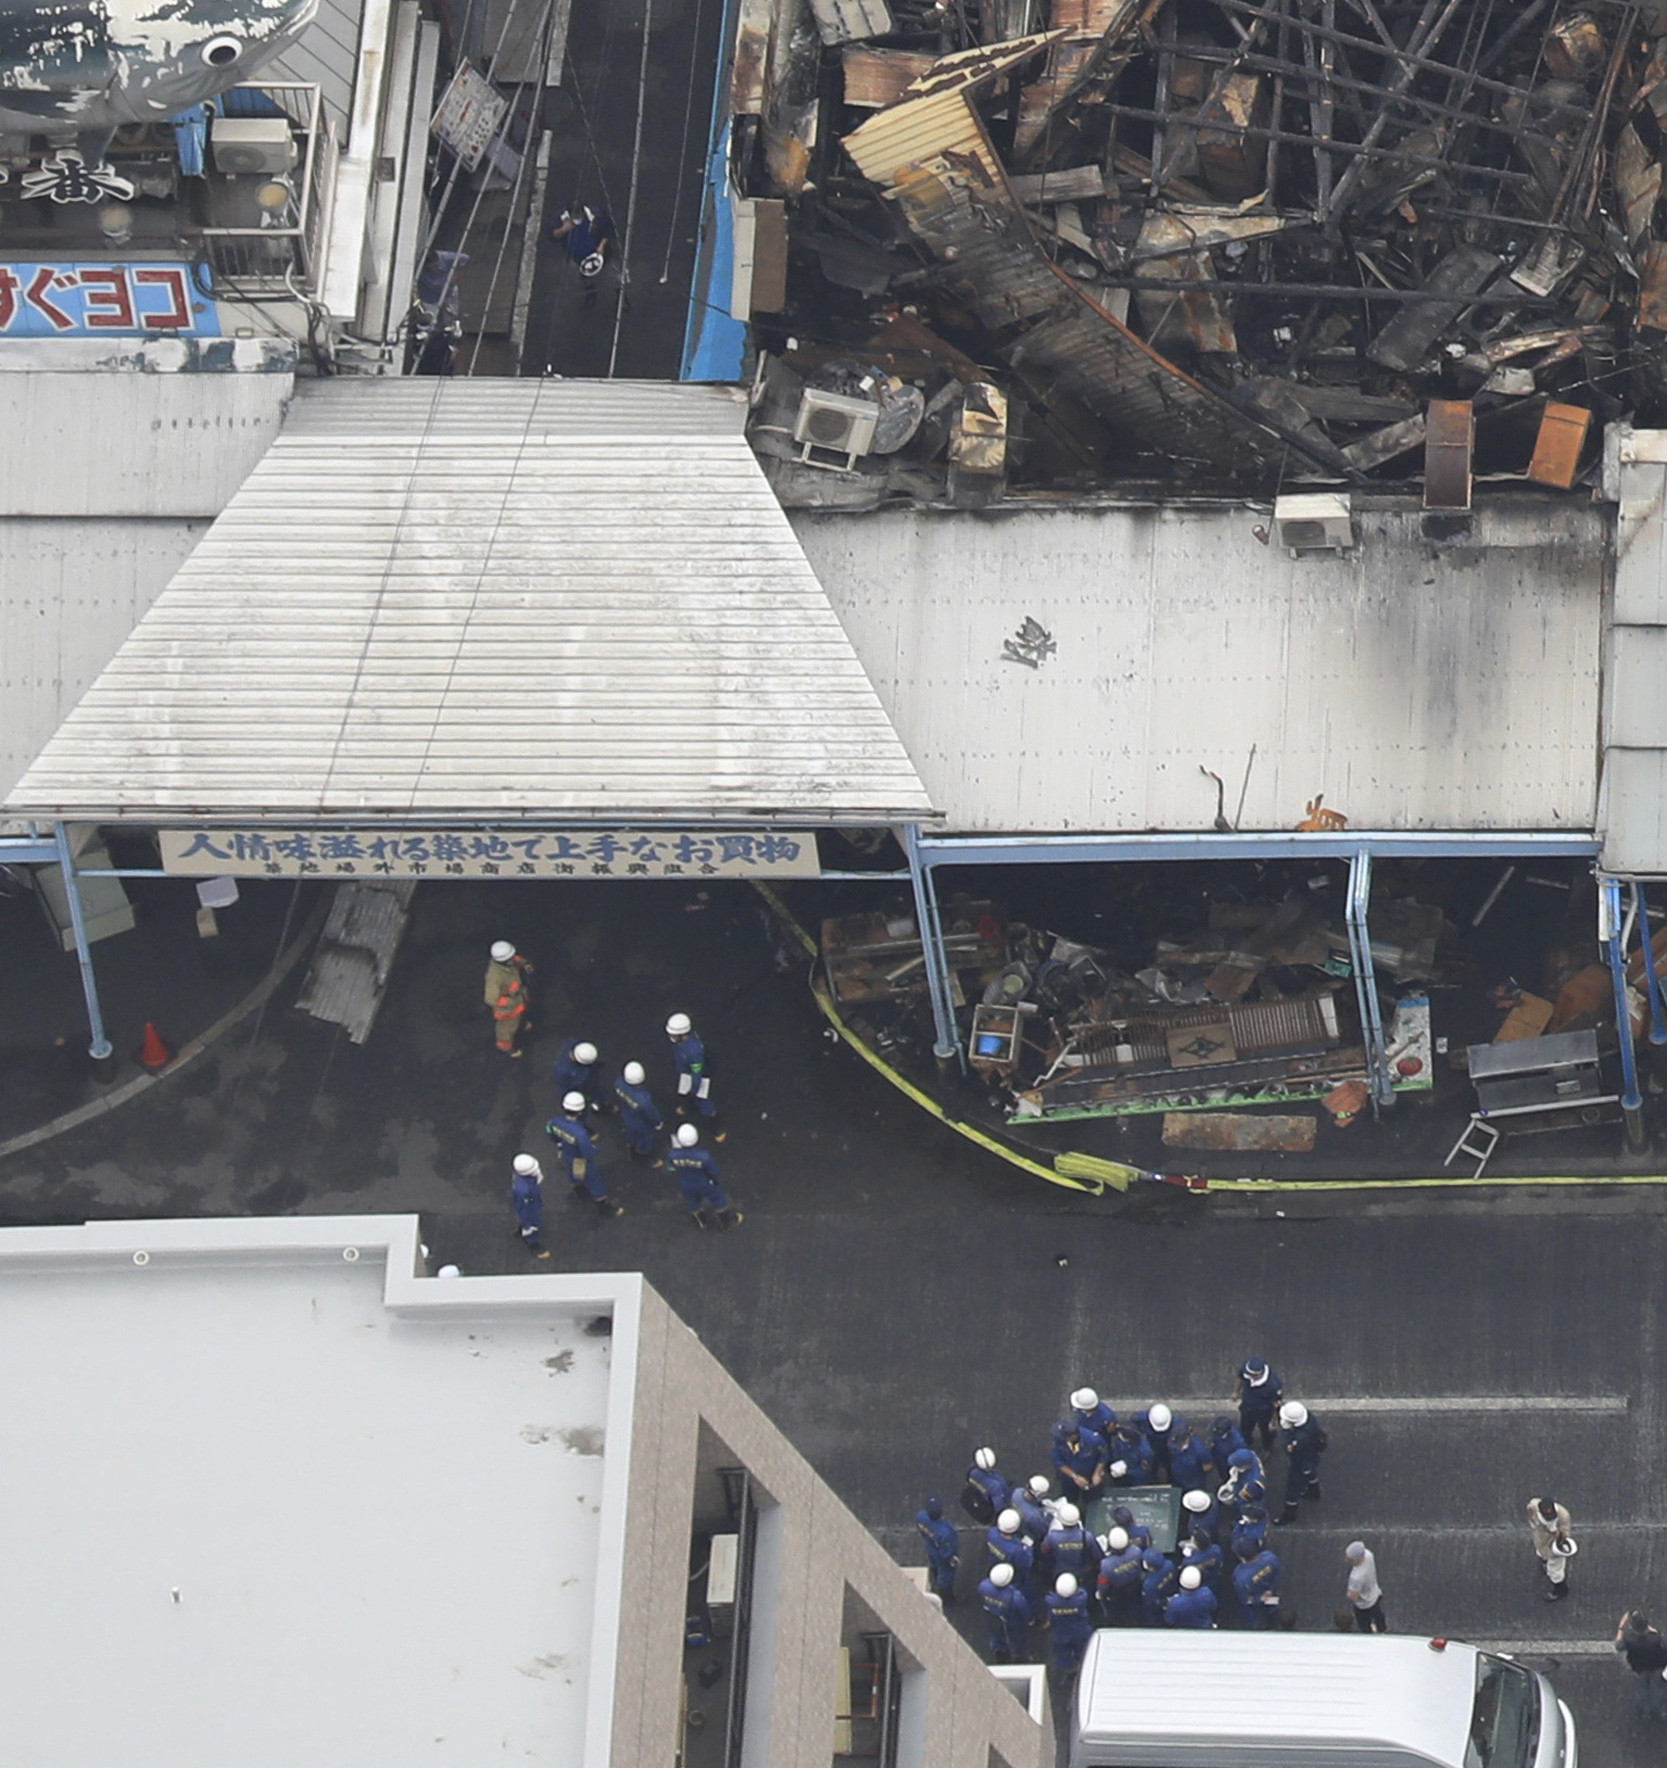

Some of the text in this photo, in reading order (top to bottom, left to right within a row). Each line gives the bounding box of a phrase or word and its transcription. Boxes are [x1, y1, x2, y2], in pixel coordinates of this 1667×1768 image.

[0, 149, 135, 205] 番
[178, 832, 801, 863] 人情味溢れる築地で上手なお買物
